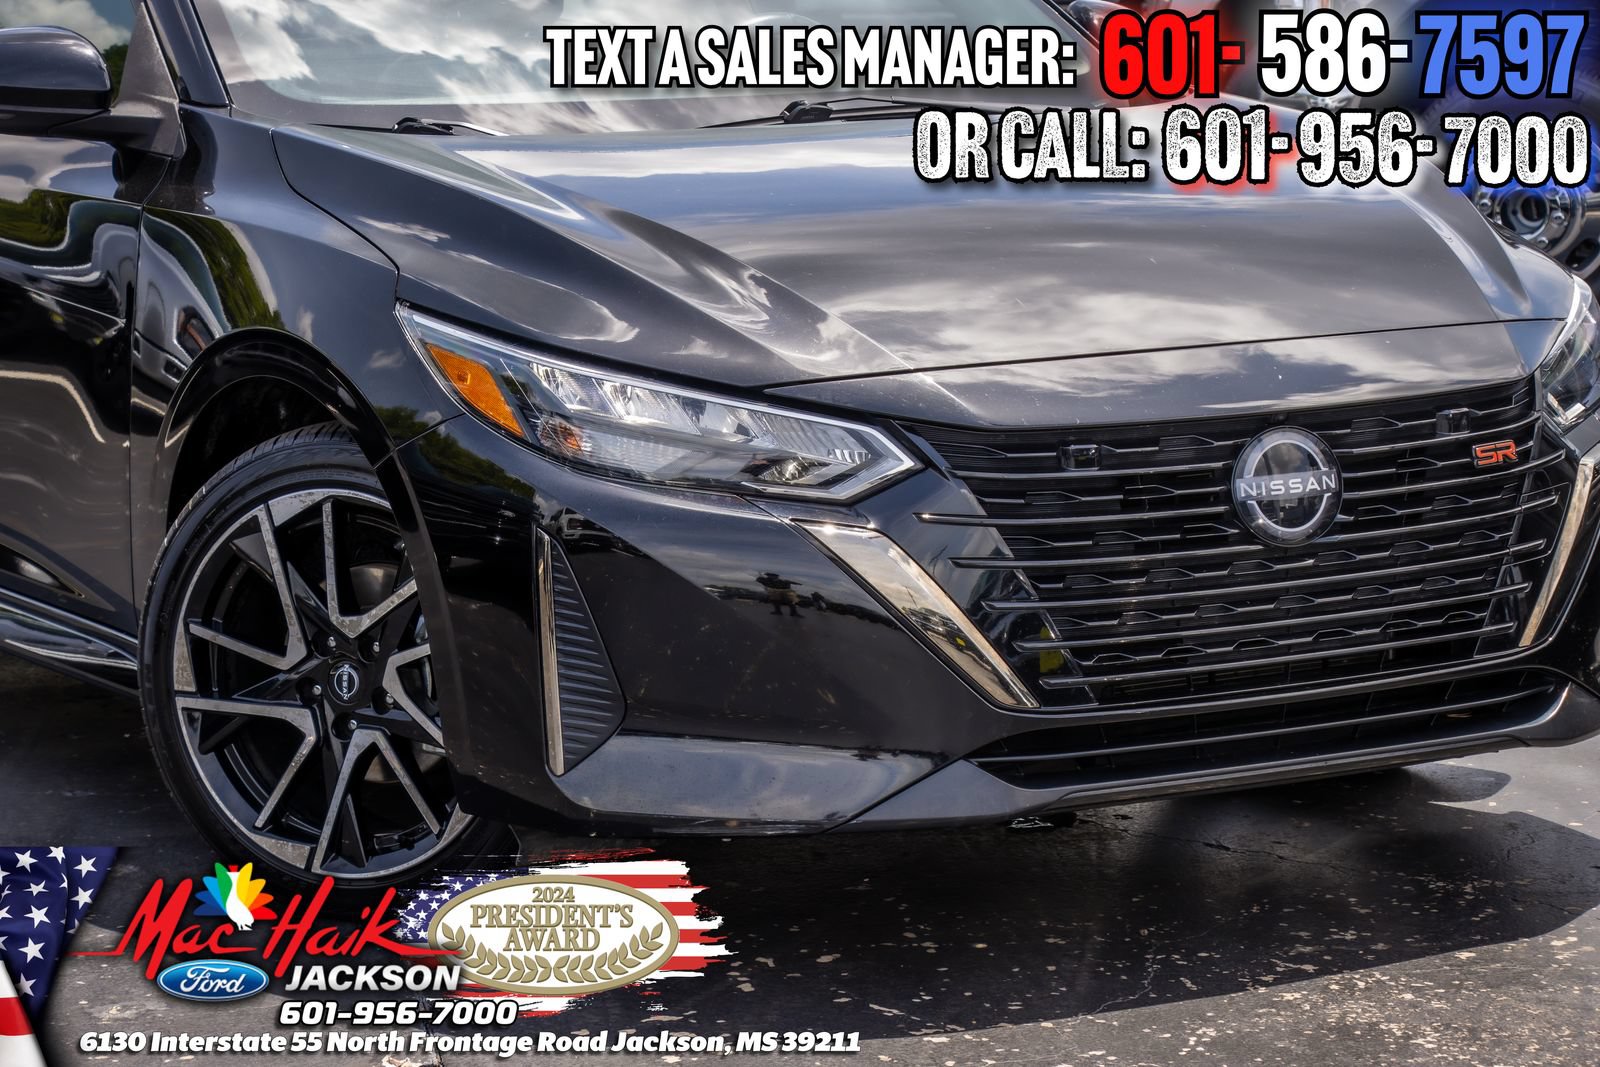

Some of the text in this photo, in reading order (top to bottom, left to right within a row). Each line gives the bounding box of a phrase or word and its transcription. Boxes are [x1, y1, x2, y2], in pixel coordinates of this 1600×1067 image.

[1473, 440, 1518, 468] SR
[1239, 473, 1337, 498] NISSAN
[341, 664, 351, 701] NISSAN
